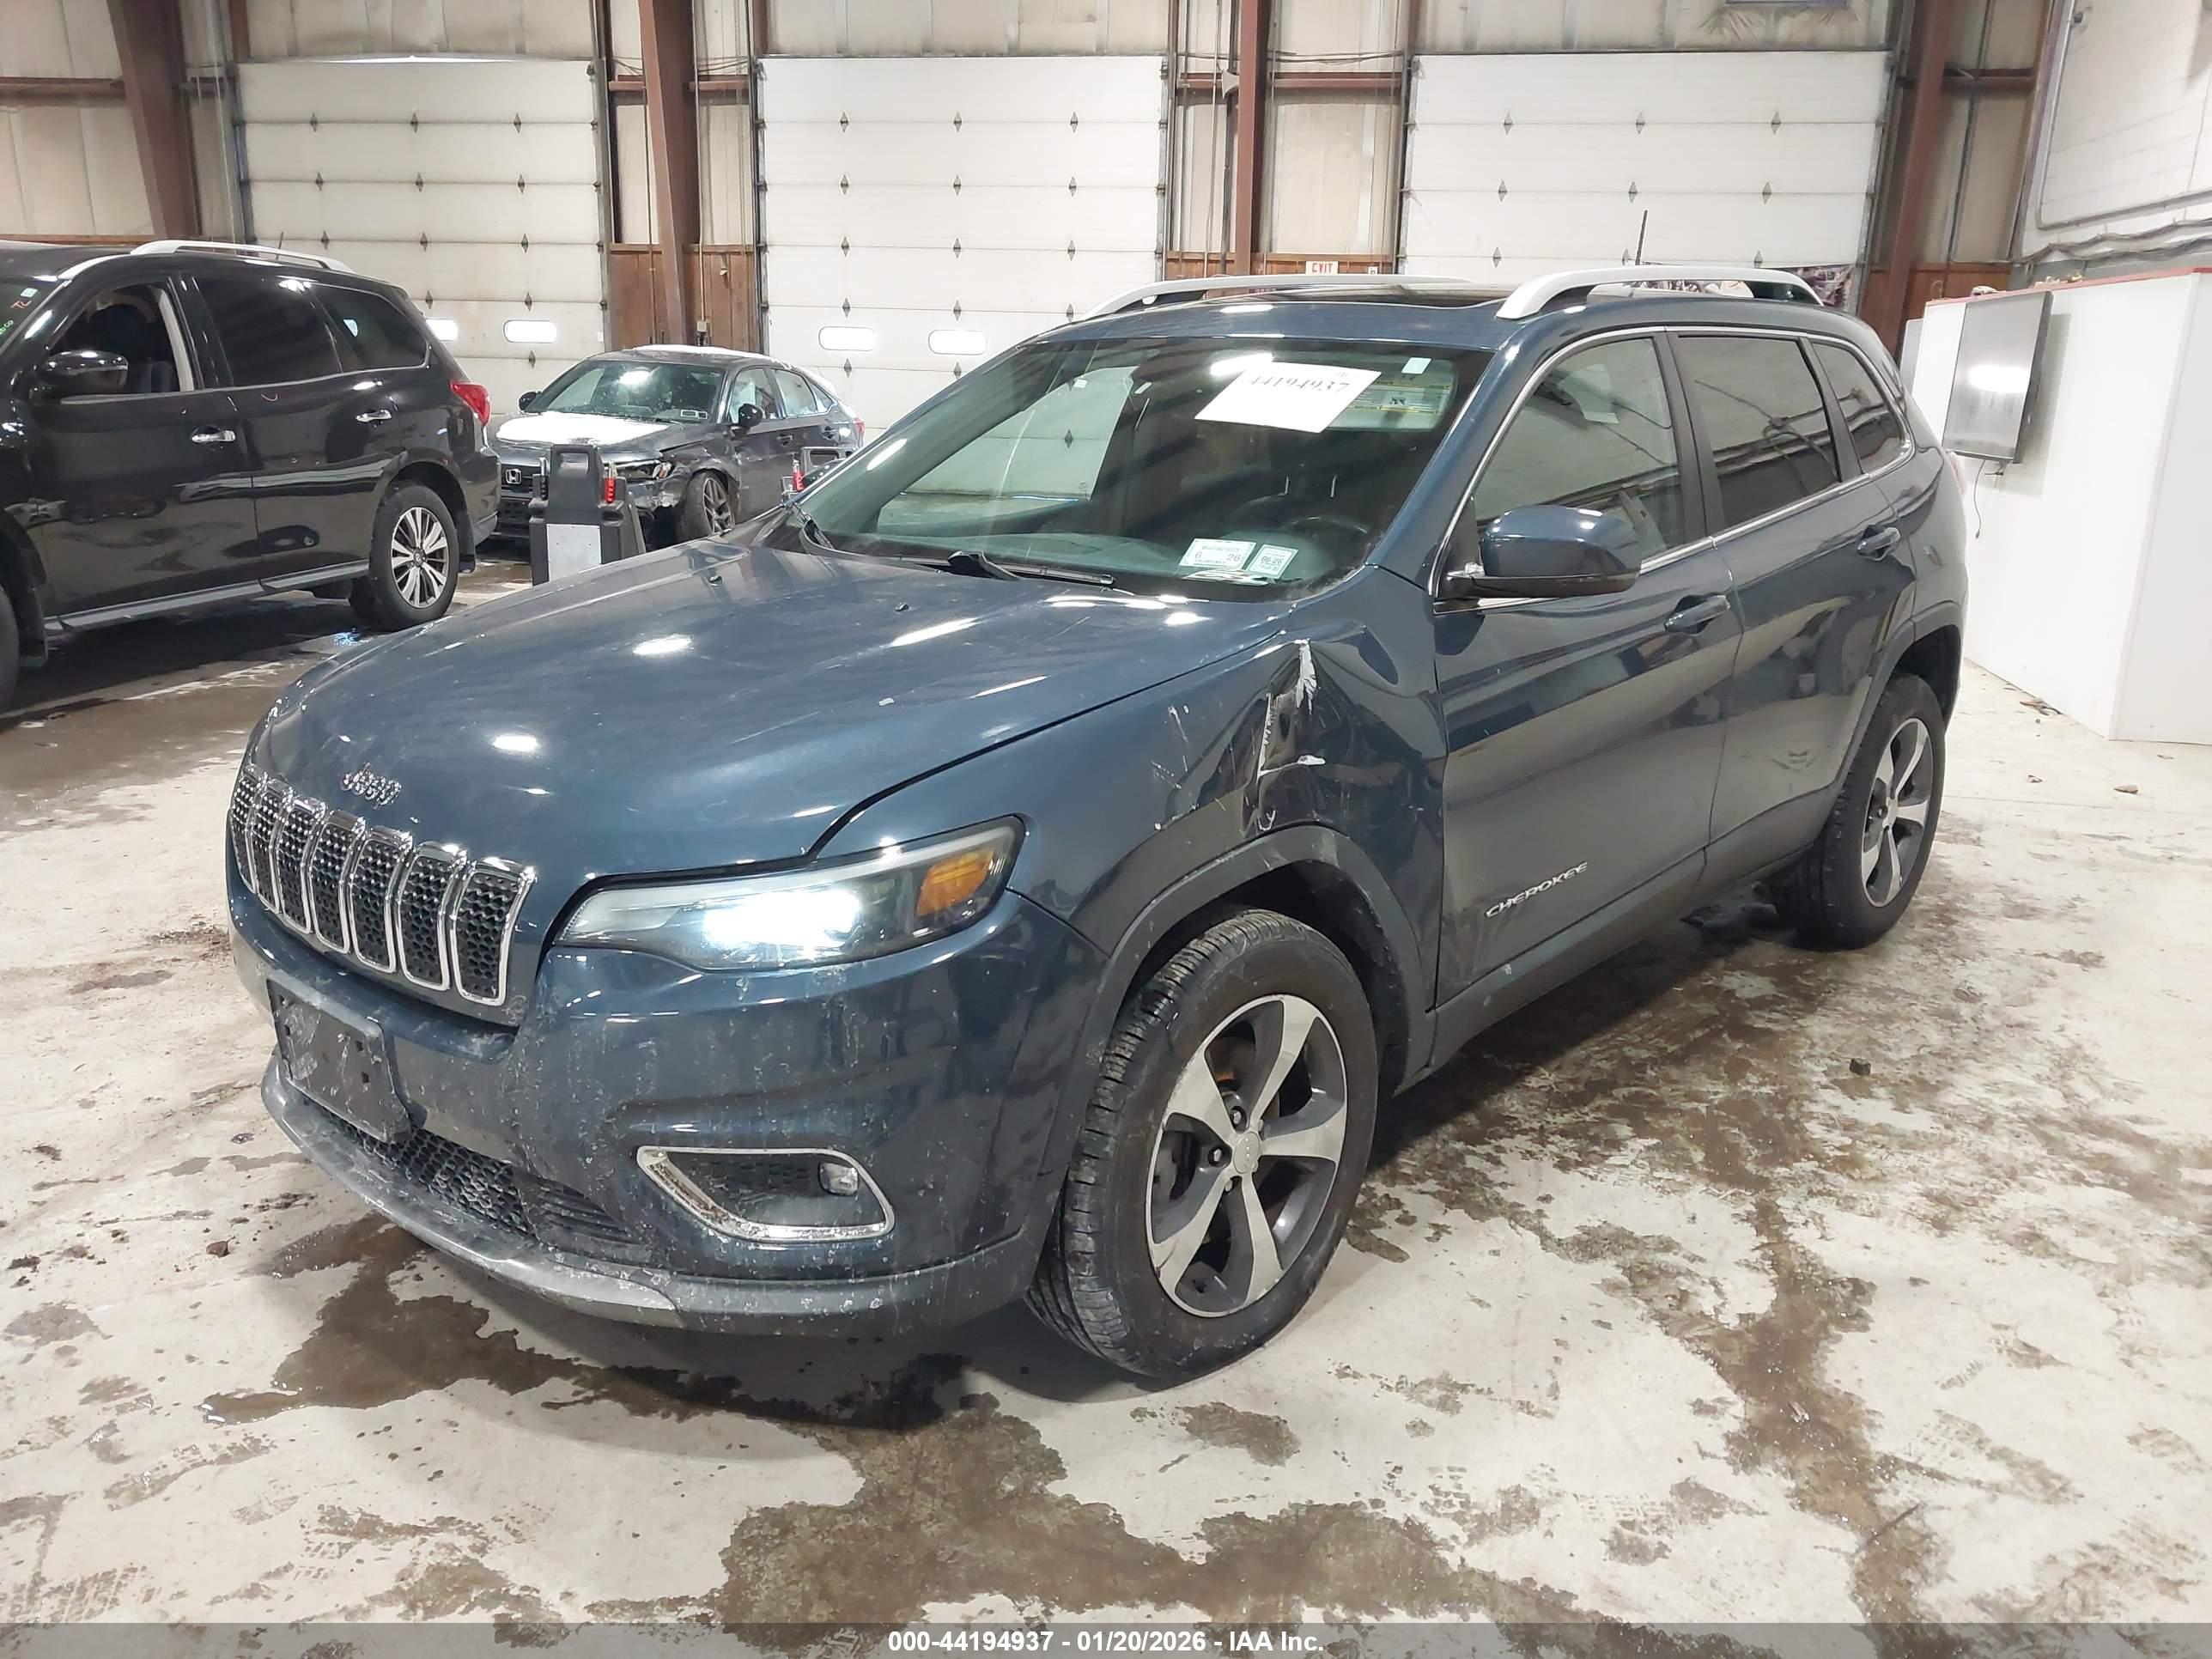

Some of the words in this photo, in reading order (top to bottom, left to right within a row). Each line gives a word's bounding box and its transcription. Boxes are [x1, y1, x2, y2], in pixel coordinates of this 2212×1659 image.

[1312, 262, 1333, 274] EXIT
[1249, 375, 1351, 393] 44194937
[339, 762, 402, 810] Jeep
[1486, 860, 1589, 918] CHEROKEE
